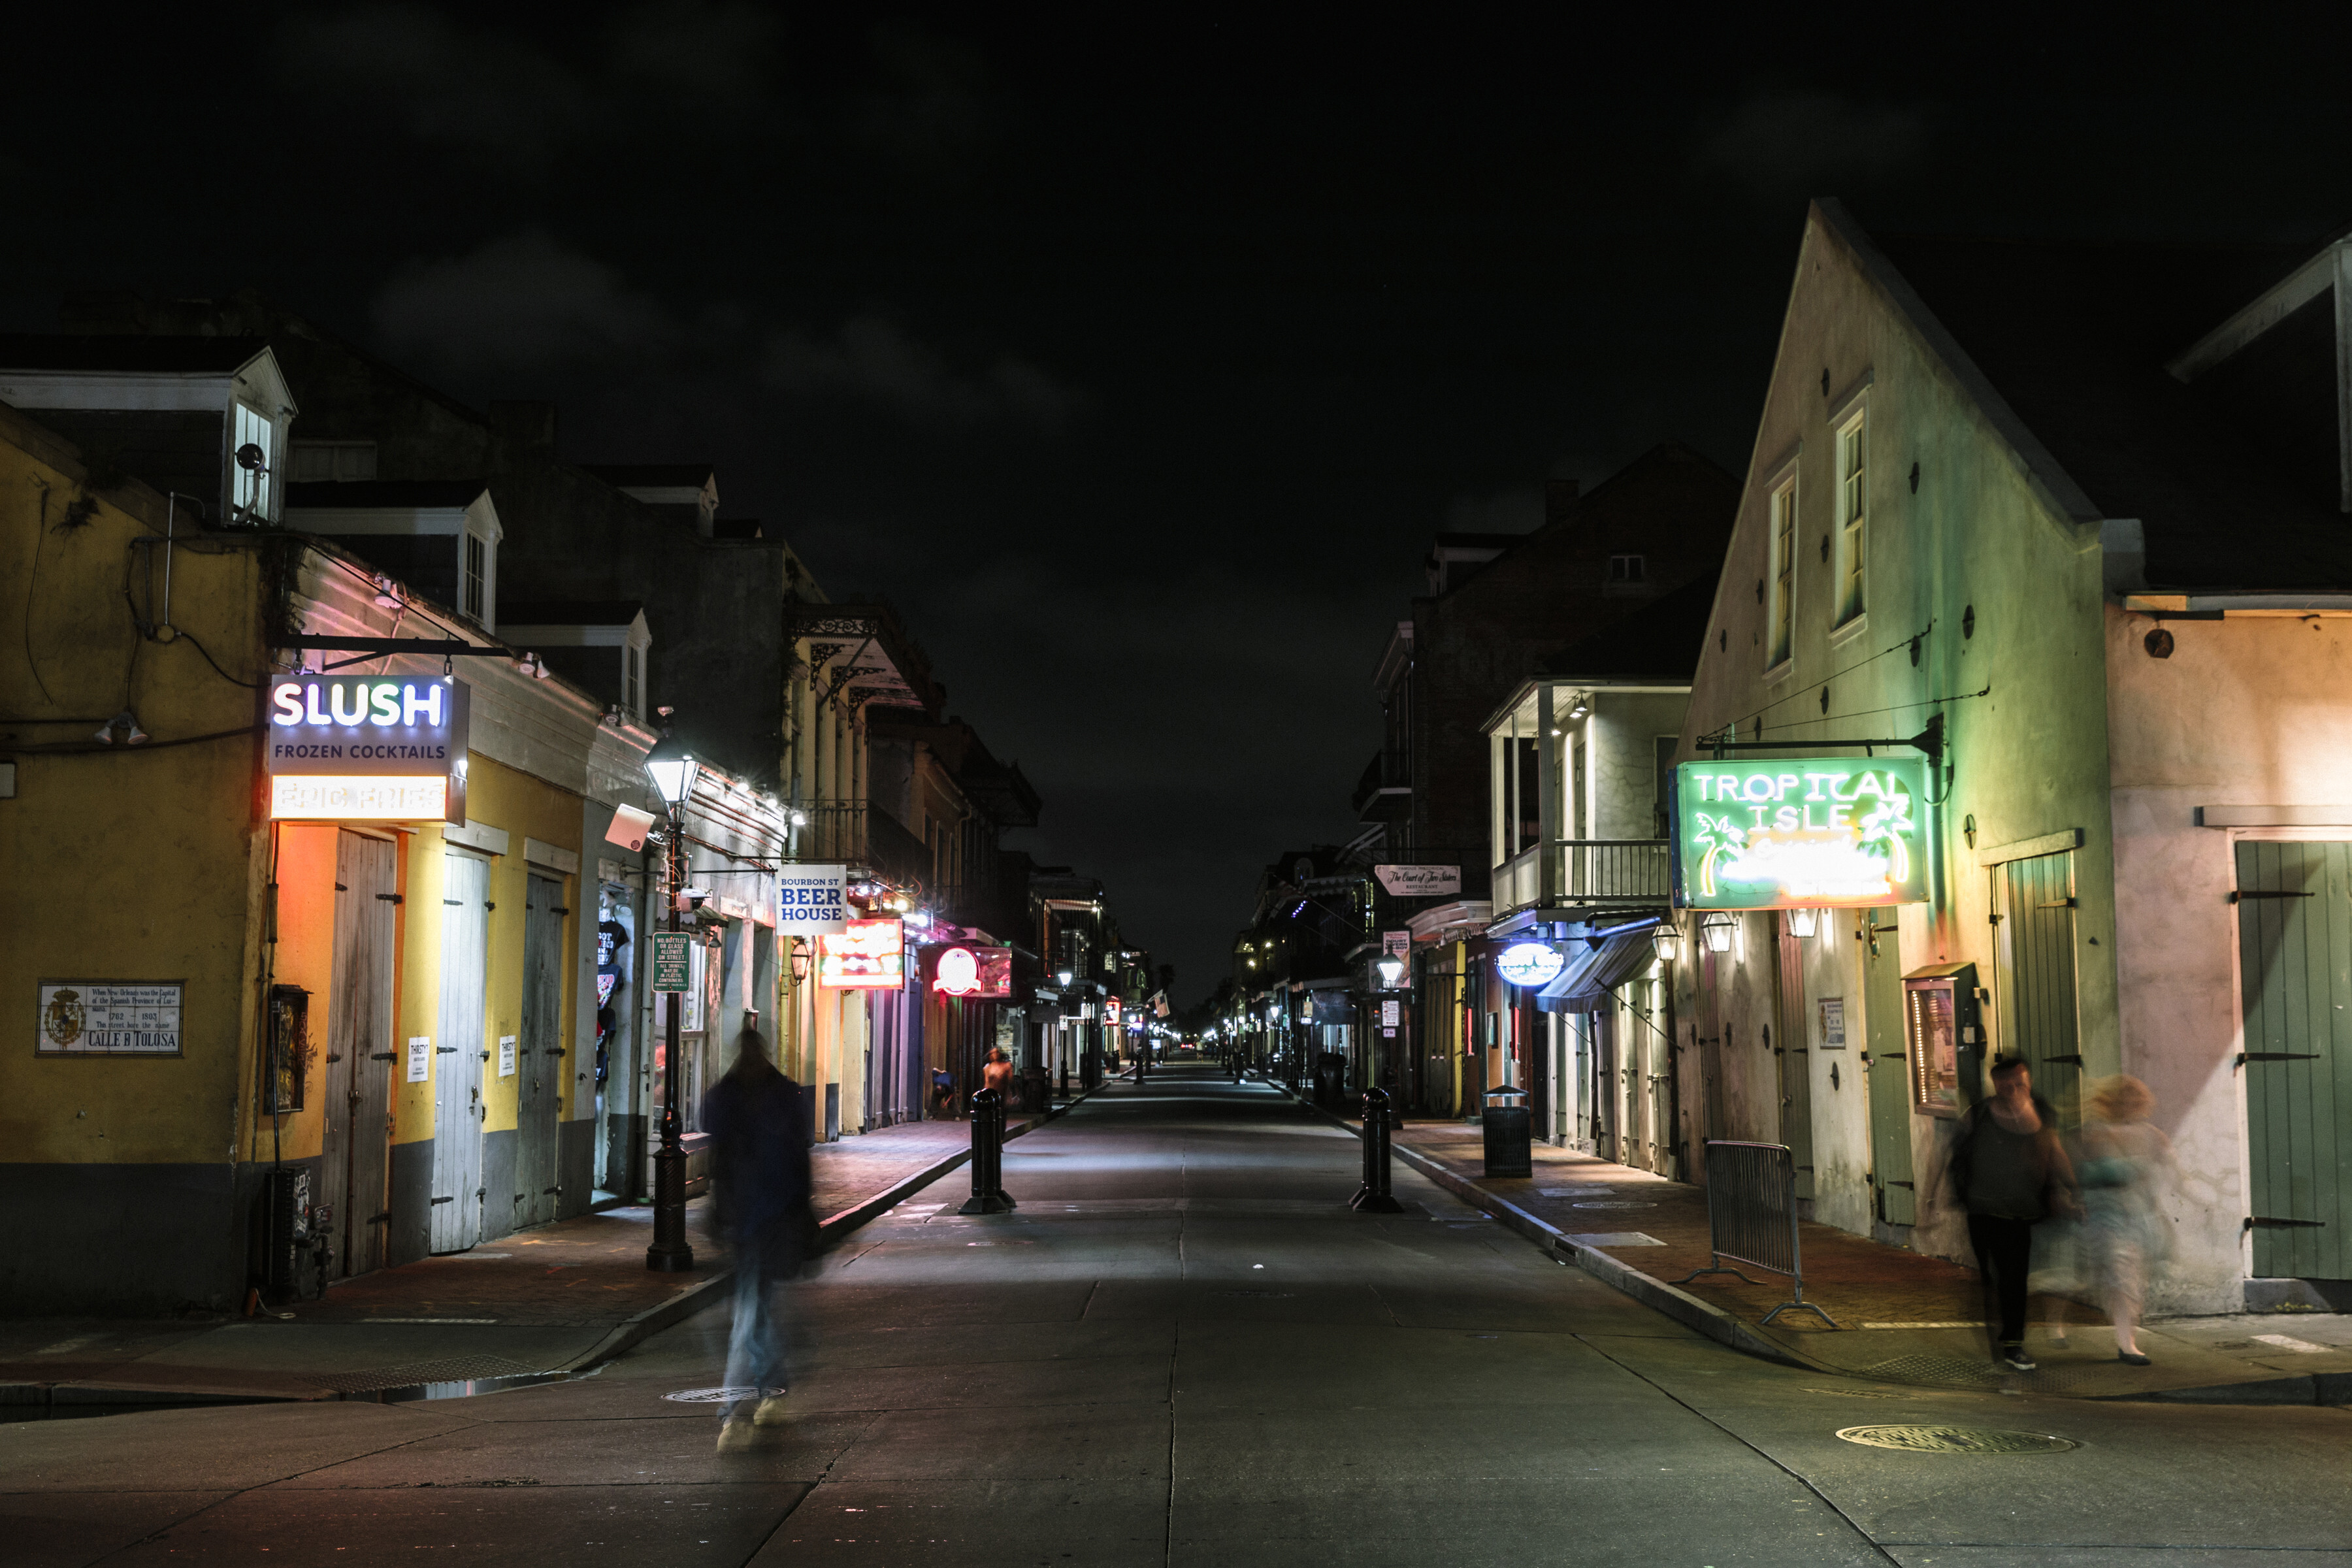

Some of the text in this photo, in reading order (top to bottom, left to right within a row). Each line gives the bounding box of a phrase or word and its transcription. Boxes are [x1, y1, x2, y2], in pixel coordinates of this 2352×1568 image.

[273, 683, 442, 726] SLUSH
[274, 745, 446, 759] FROZEN COCKTAILS
[1693, 771, 1910, 802] TROPICAL
[281, 783, 446, 809] EPIC FRIES
[1748, 804, 1854, 832] ISLE
[1387, 871, 1401, 884] The
[1402, 871, 1418, 882] Court
[1418, 873, 1426, 883] of
[781, 889, 842, 905] BEER
[781, 908, 842, 921] HOUSE
[120, 988, 139, 996] Orleans
[160, 988, 176, 998] Capital
[110, 997, 130, 1006] Spanish
[89, 1030, 121, 1046] CALLE
[133, 1030, 176, 1046] TOLOSA
